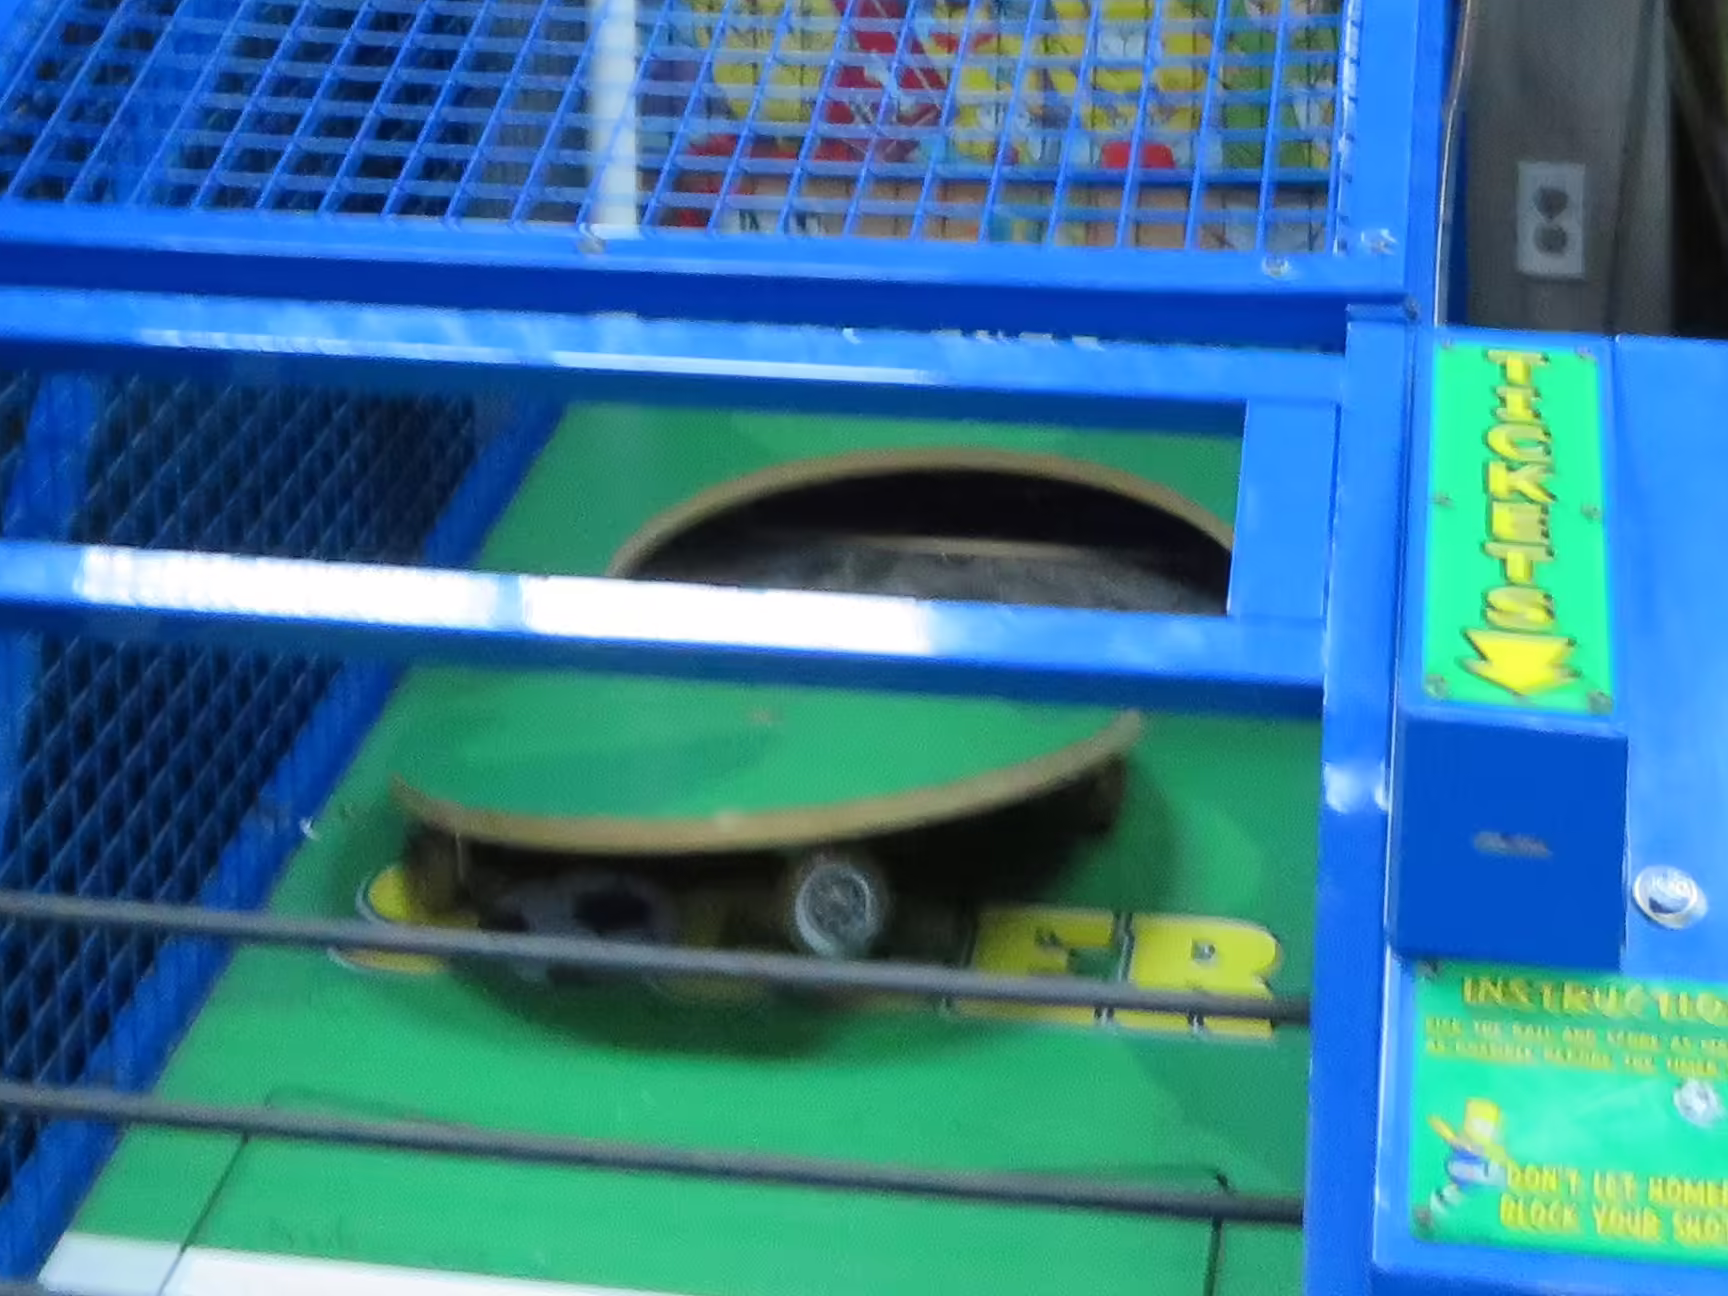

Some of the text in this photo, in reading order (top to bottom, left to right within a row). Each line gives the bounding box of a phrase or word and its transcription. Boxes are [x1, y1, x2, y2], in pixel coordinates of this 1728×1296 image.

[1483, 348, 1558, 632] TICKETS
[1506, 1161, 1581, 1196] DON'T
[1592, 1203, 1663, 1242] YOUR
